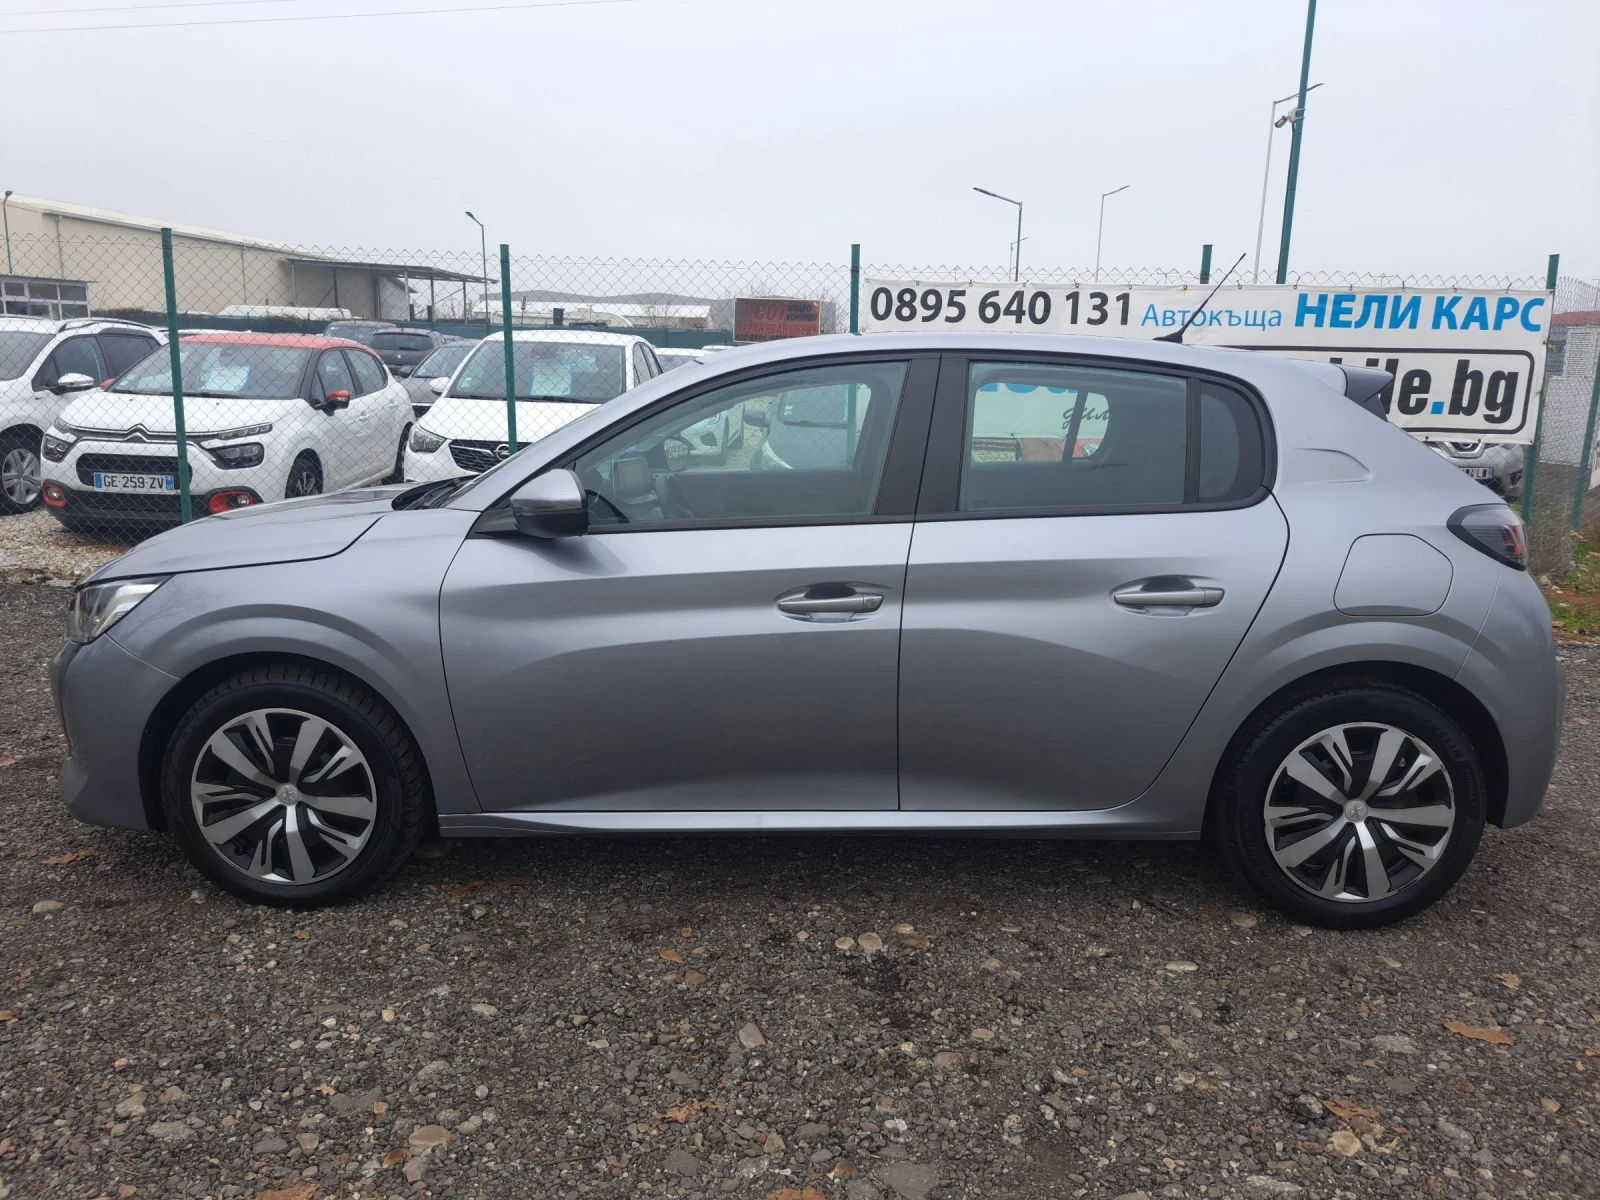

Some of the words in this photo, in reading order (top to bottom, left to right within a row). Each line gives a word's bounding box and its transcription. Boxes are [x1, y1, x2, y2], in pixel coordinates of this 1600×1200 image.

[870, 287, 966, 323] 0895
[978, 290, 1051, 325] 640
[1065, 291, 1130, 326] 131
[1141, 303, 1282, 331] Автокъща
[1294, 293, 1422, 329] НЕЛИ
[1431, 296, 1545, 332] КАРС
